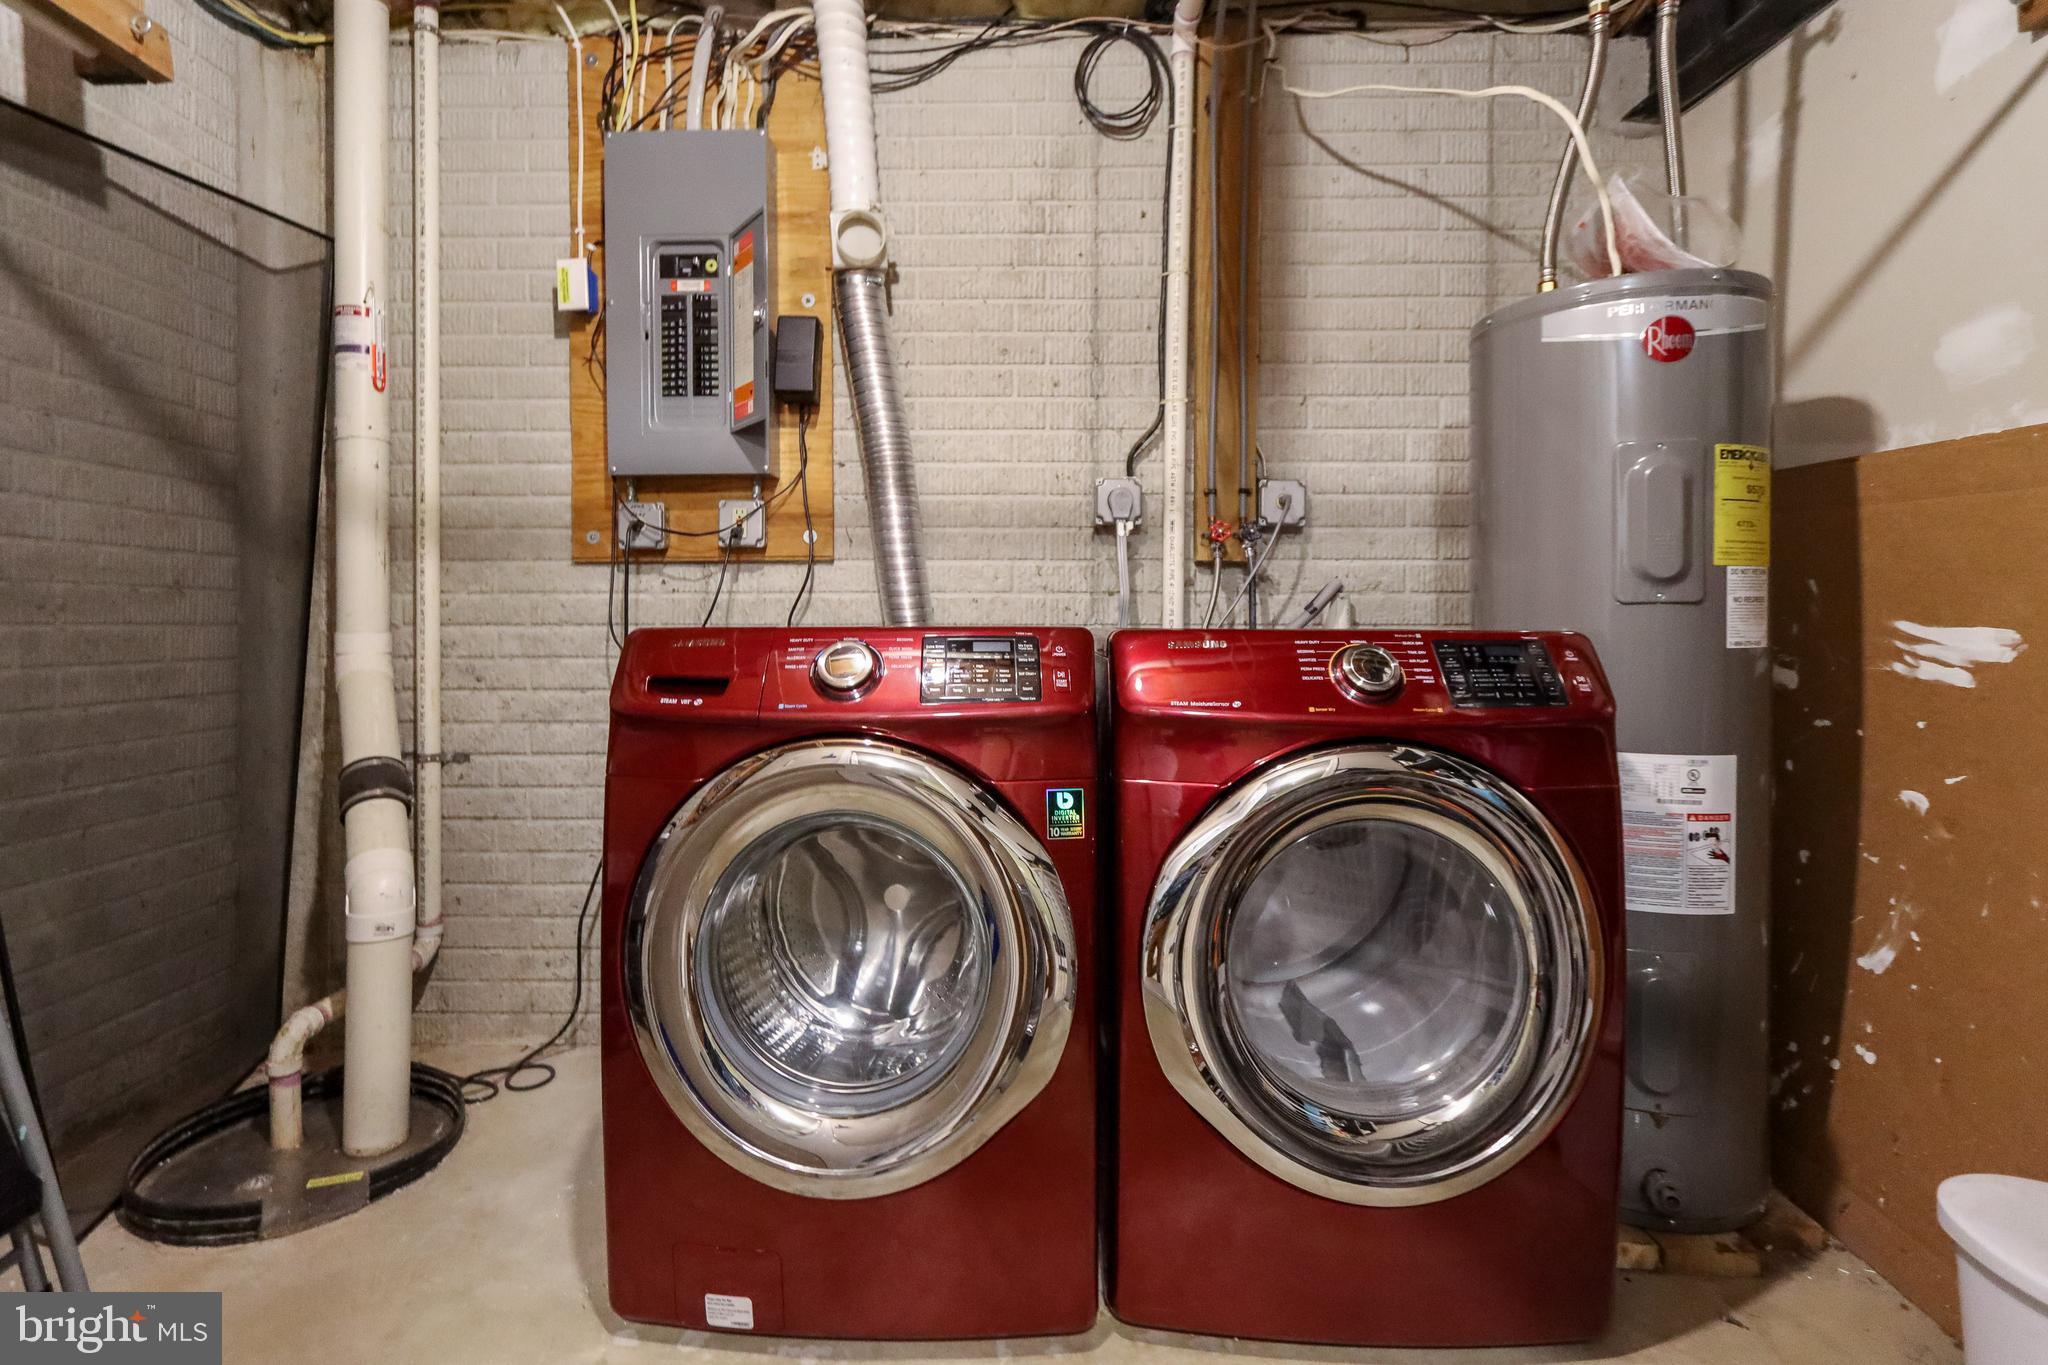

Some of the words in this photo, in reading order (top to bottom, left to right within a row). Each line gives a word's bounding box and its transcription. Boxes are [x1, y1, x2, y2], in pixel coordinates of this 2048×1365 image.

[1648, 318, 1693, 355] Rheem
[1167, 640, 1227, 649] SAMSUNG
[1050, 827, 1060, 837] 10
